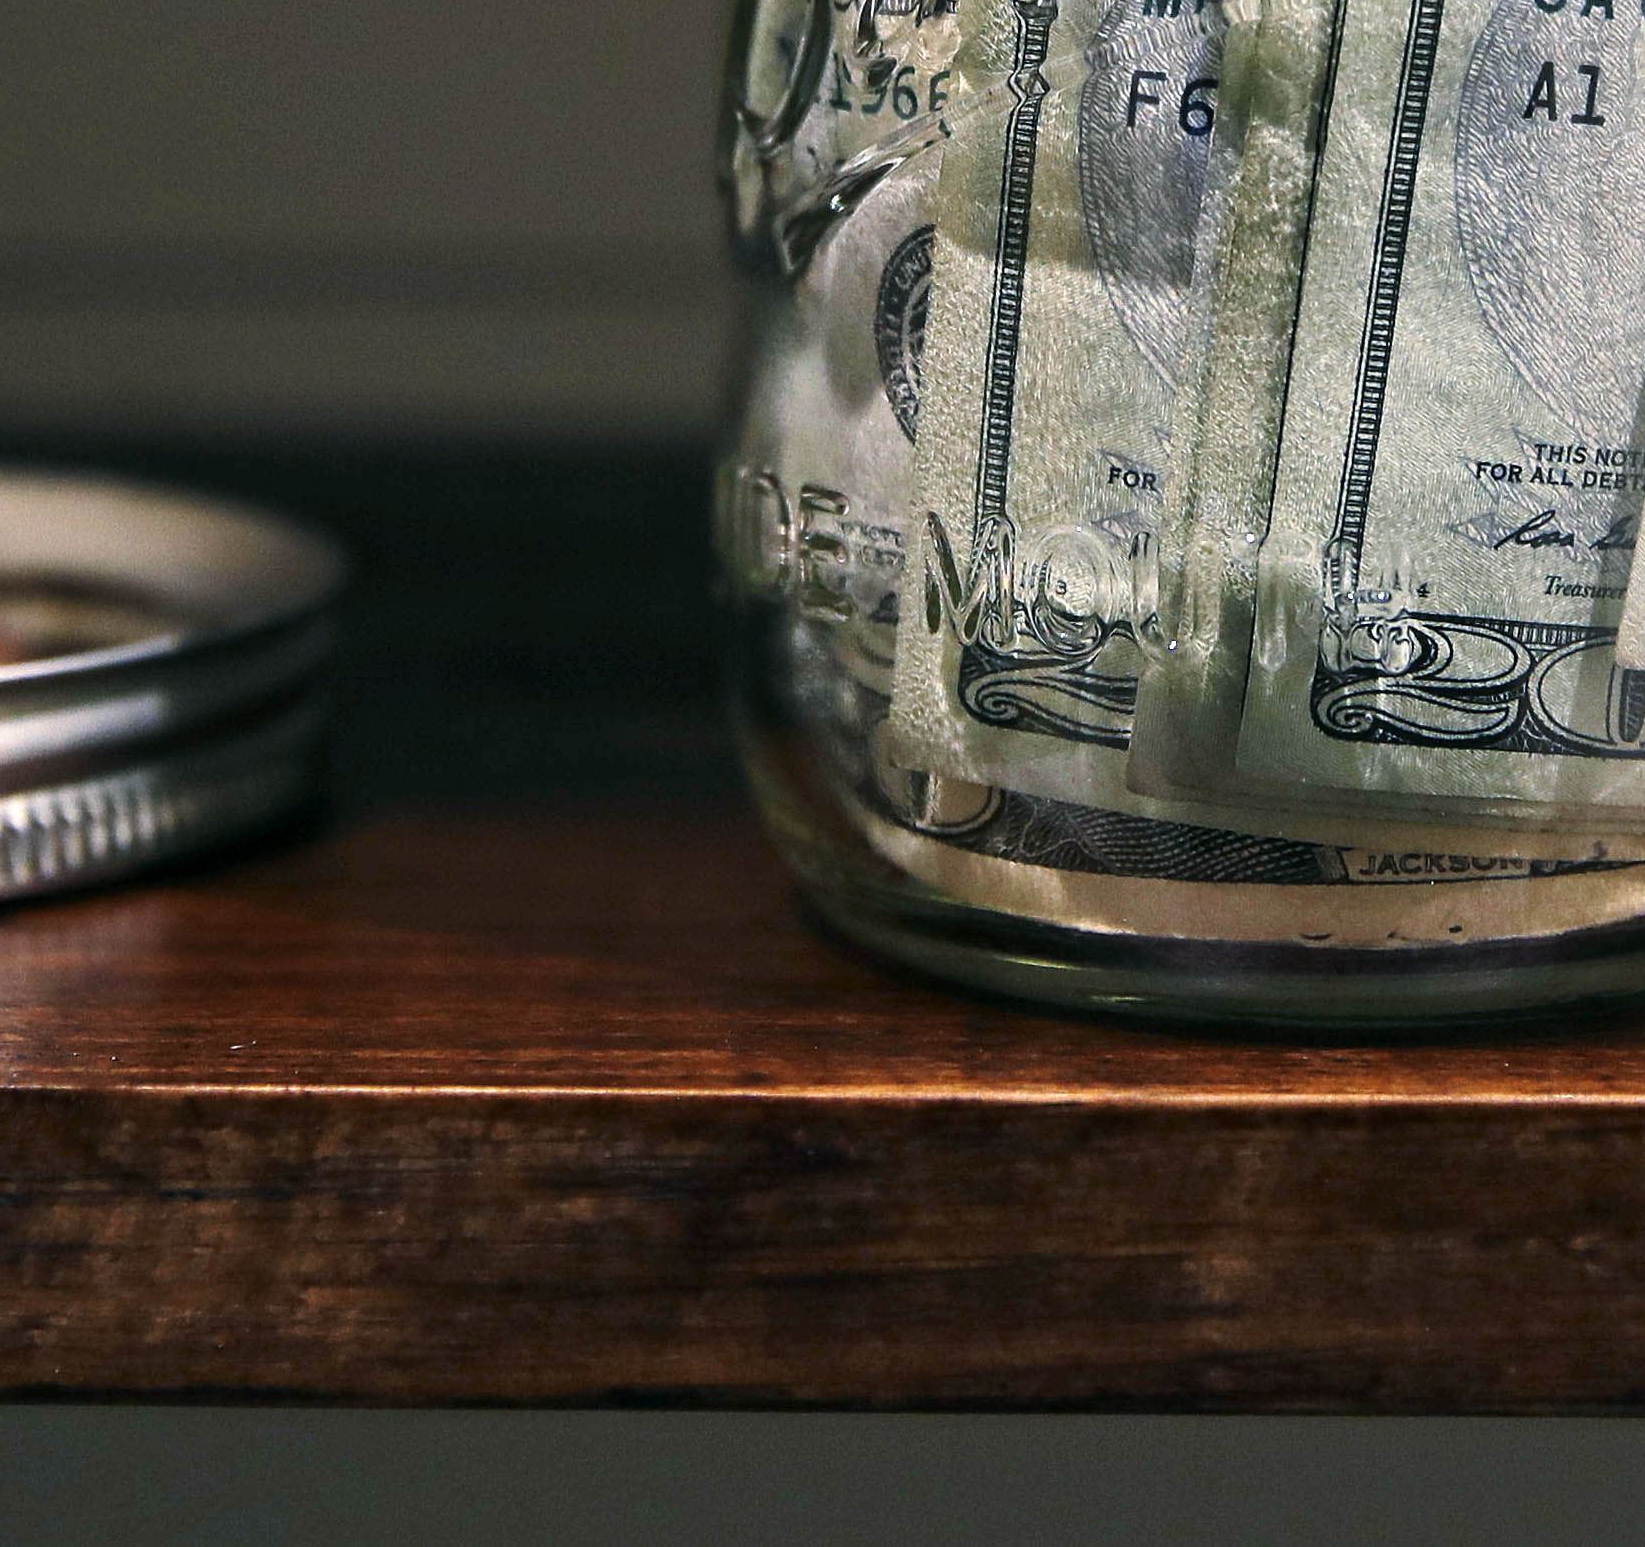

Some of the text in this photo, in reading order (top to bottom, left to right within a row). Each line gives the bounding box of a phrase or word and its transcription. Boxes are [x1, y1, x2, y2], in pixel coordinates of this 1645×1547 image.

[1126, 69, 1220, 137] F6
[1522, 61, 1605, 126] A1
[1534, 443, 1589, 465] THIS
[1107, 466, 1158, 487] FOR
[1476, 460, 1523, 484] FOR
[1529, 467, 1574, 487] ALL
